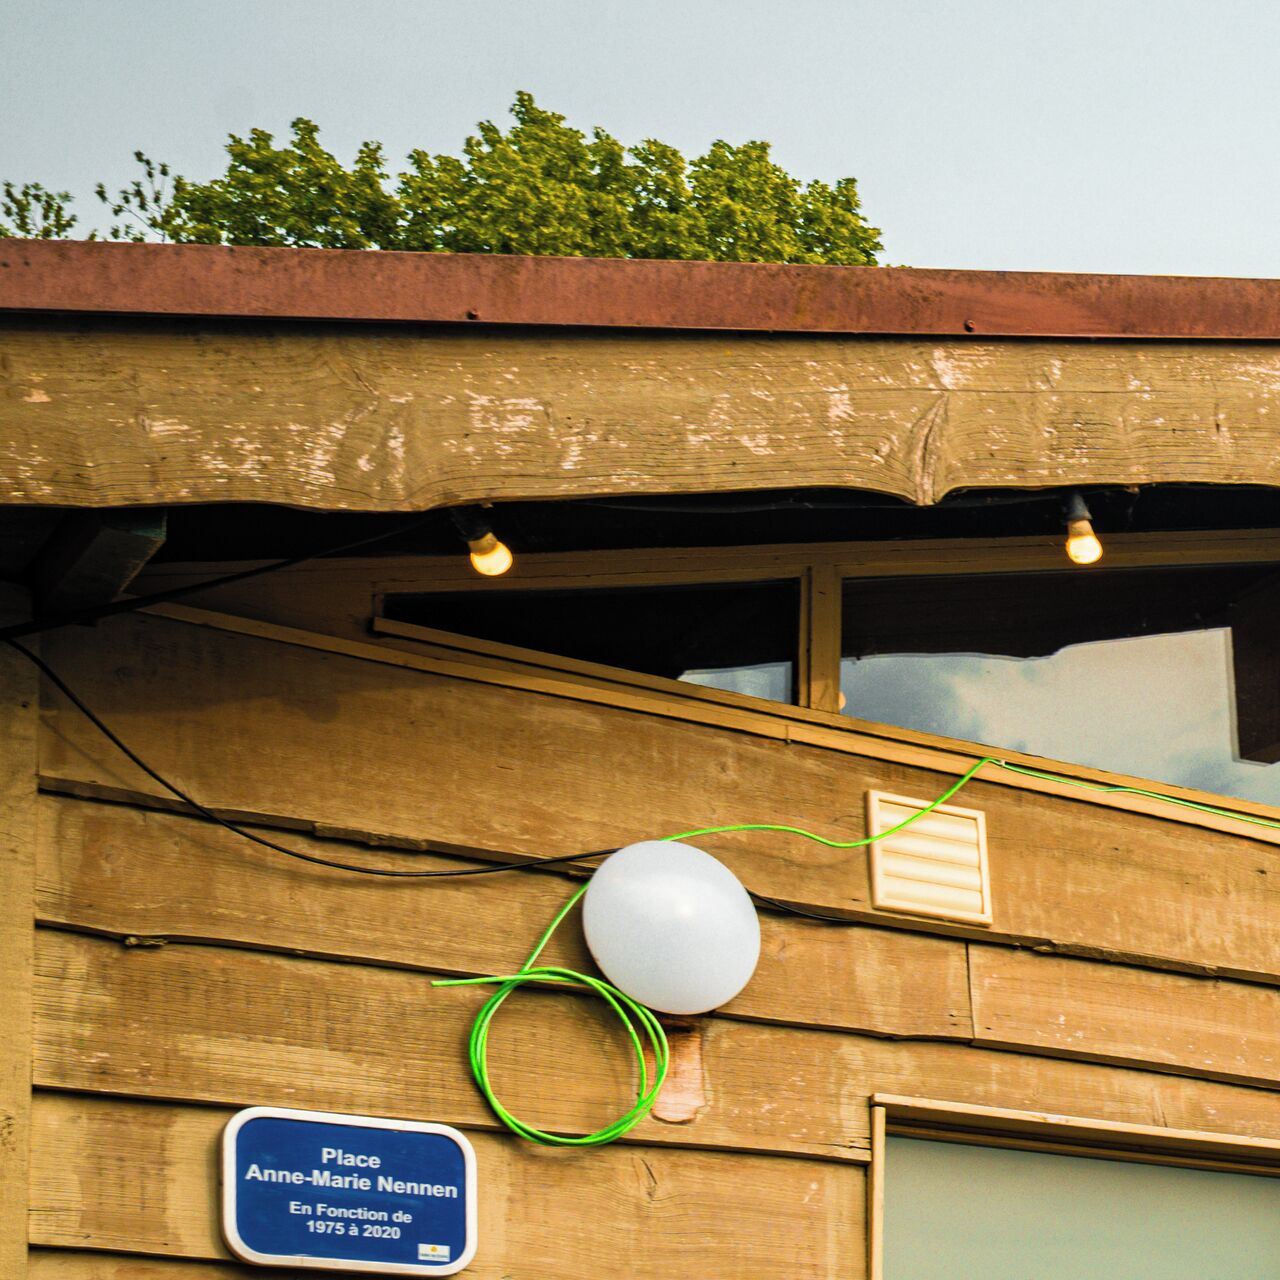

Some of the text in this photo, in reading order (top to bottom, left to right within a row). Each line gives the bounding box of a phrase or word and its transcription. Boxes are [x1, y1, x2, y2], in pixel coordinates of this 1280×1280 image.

[321, 1147, 382, 1169] Place
[245, 1164, 458, 1198] Anne-Marie Nennen
[289, 1201, 412, 1223] En Fonction de
[306, 1220, 401, 1239] 1975 à 2020
